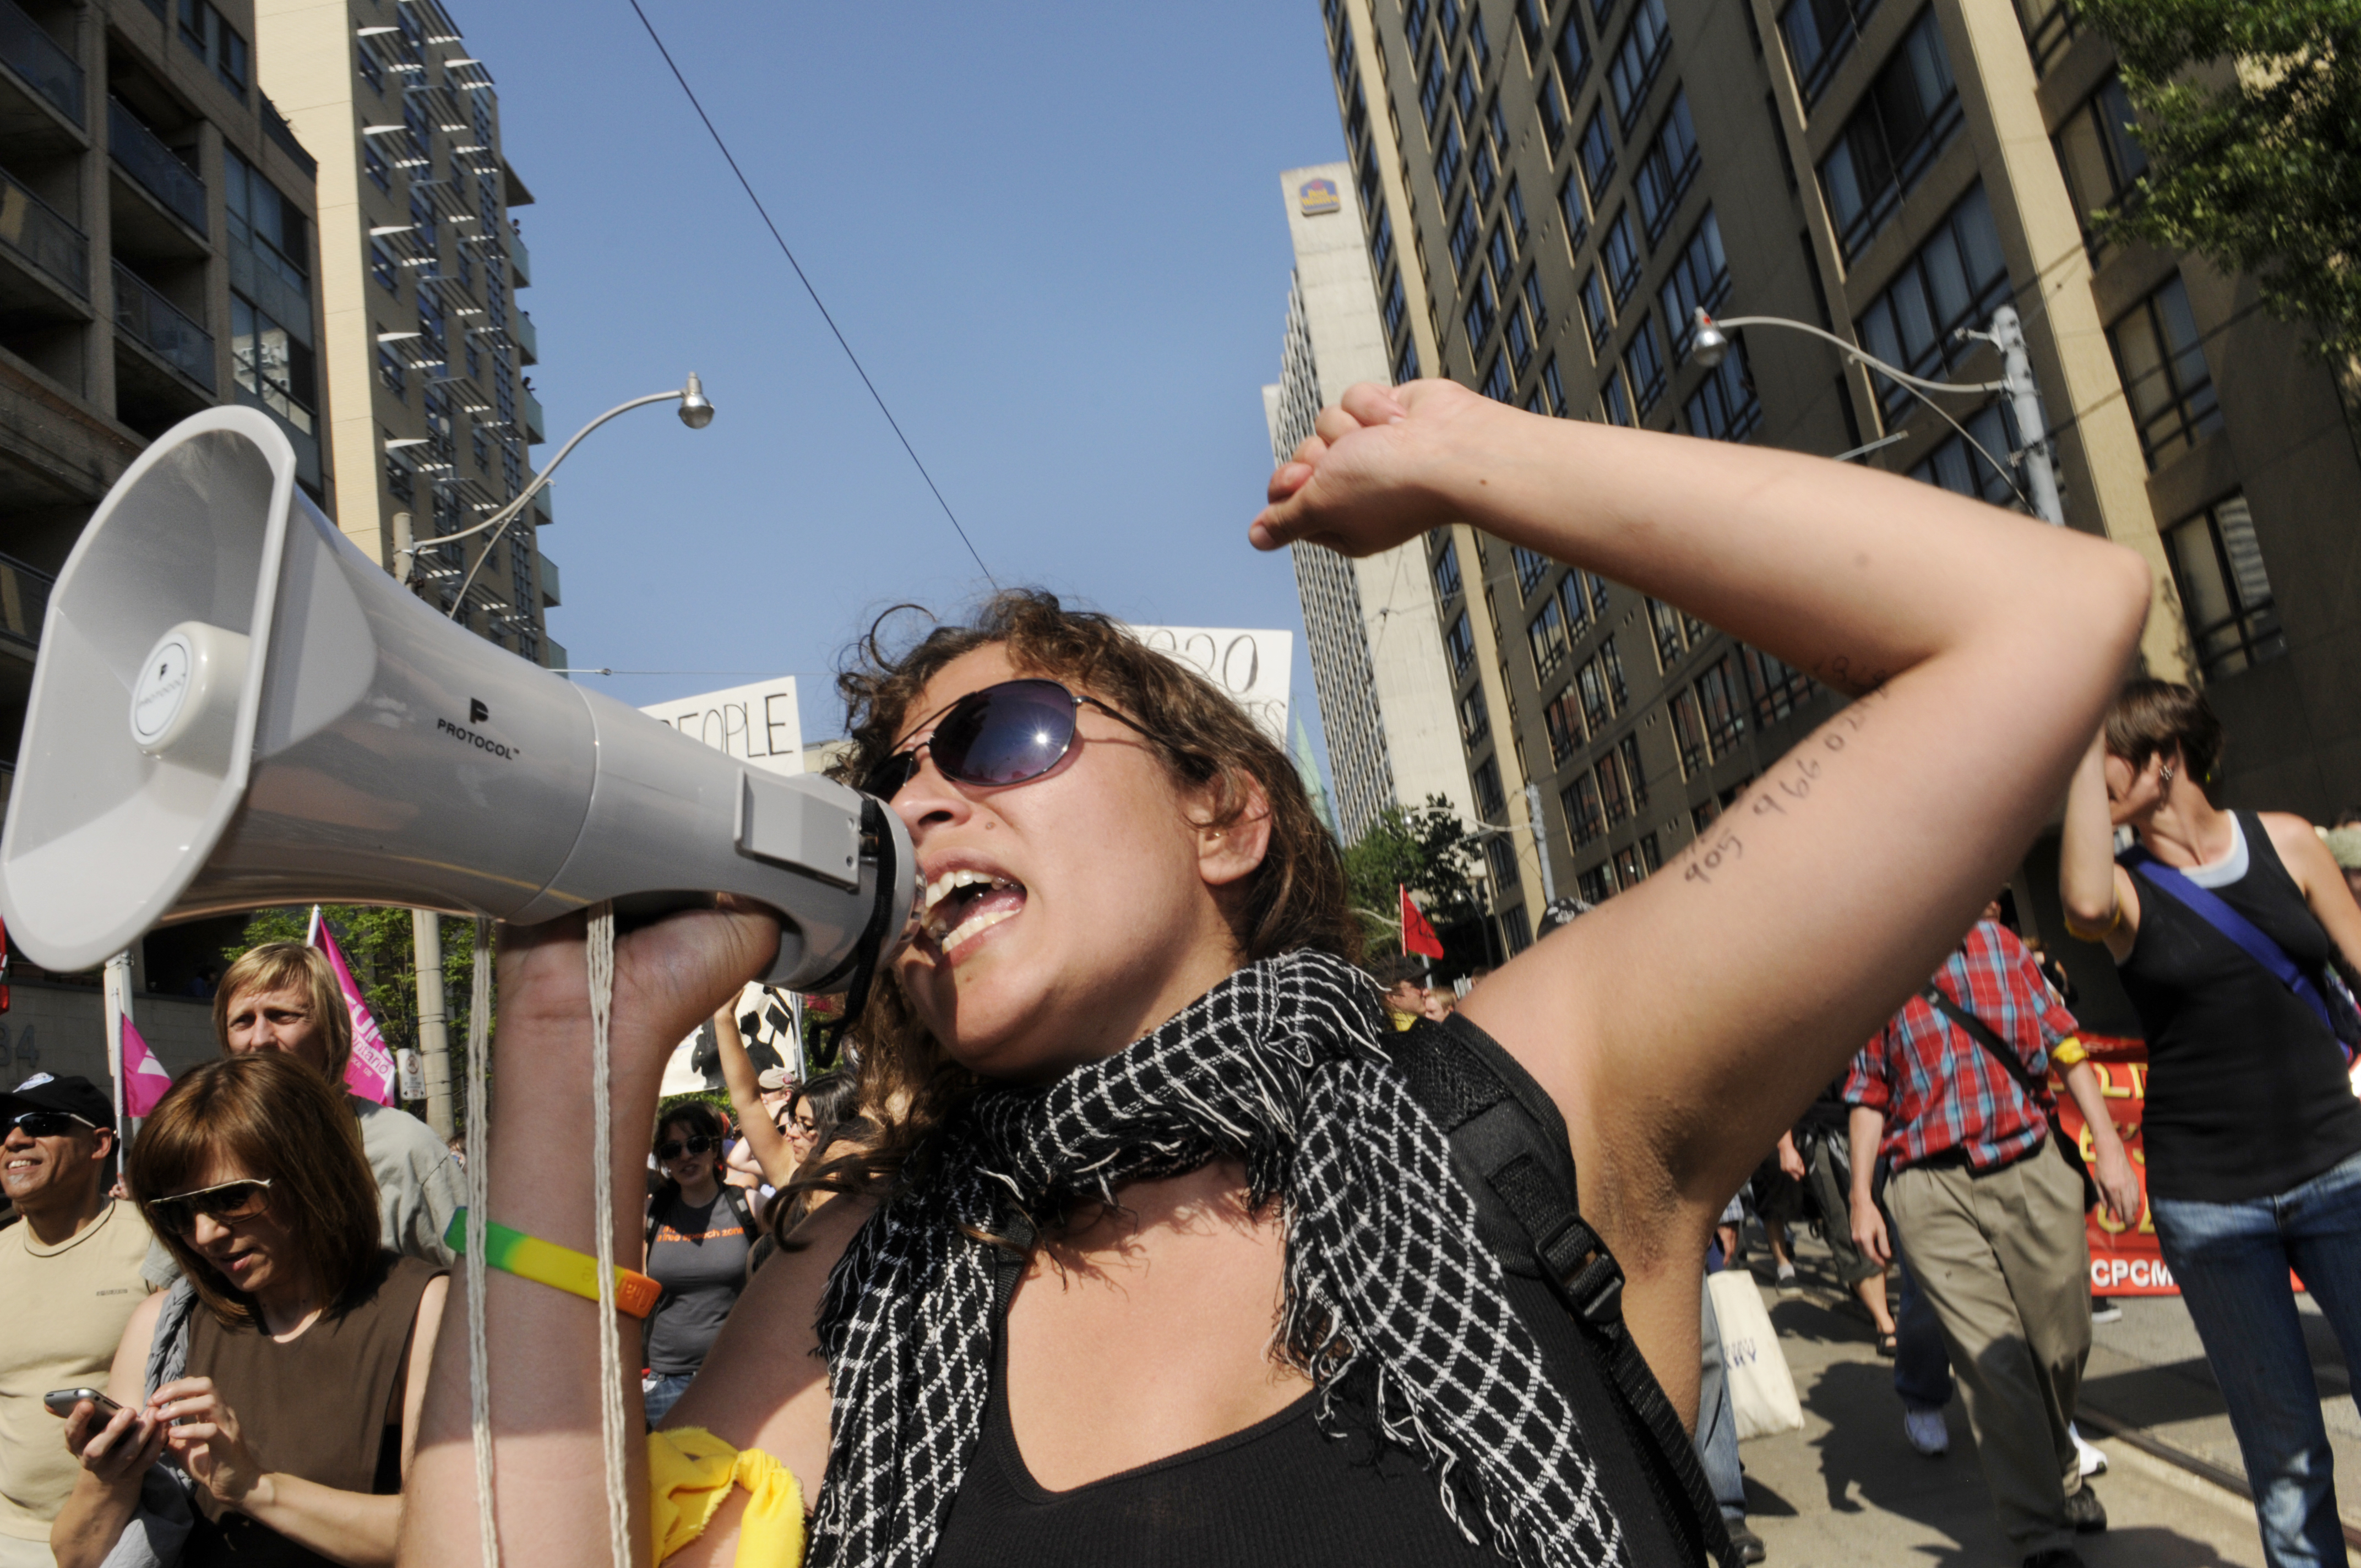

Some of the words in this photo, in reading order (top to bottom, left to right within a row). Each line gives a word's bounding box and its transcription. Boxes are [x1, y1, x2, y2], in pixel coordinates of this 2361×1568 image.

[1145, 629, 1259, 695] 20
[660, 693, 793, 758] OPLE
[1685, 827, 1742, 883] 905
[351, 1057, 363, 1069] OCAL
